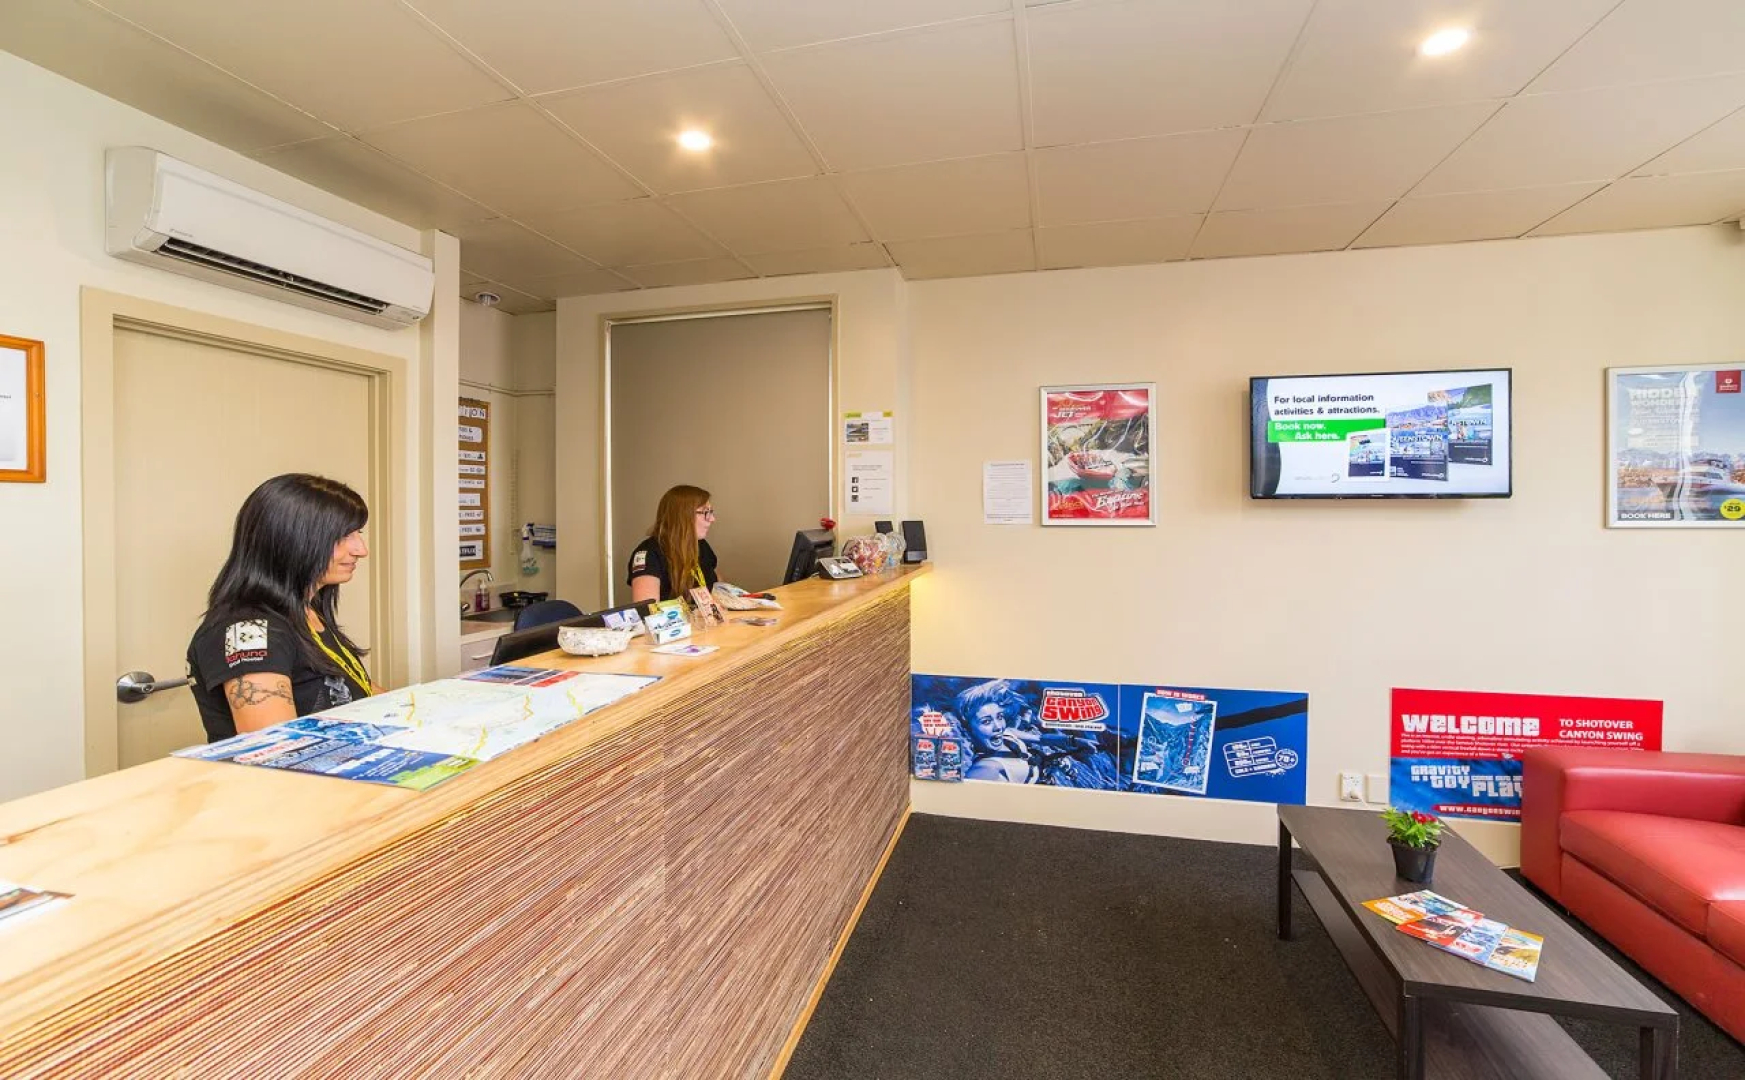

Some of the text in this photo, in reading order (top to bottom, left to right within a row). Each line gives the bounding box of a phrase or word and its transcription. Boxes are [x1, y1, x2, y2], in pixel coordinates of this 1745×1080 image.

[1274, 393, 1374, 404] For local information
[1274, 407, 1314, 416] activities
[1327, 405, 1380, 414] attractions.
[1275, 422, 1301, 431] Book
[1295, 432, 1340, 440] Ask here.
[1559, 718, 1634, 729] TO SHOTOVER
[1559, 730, 1644, 741] CANYON SWING
